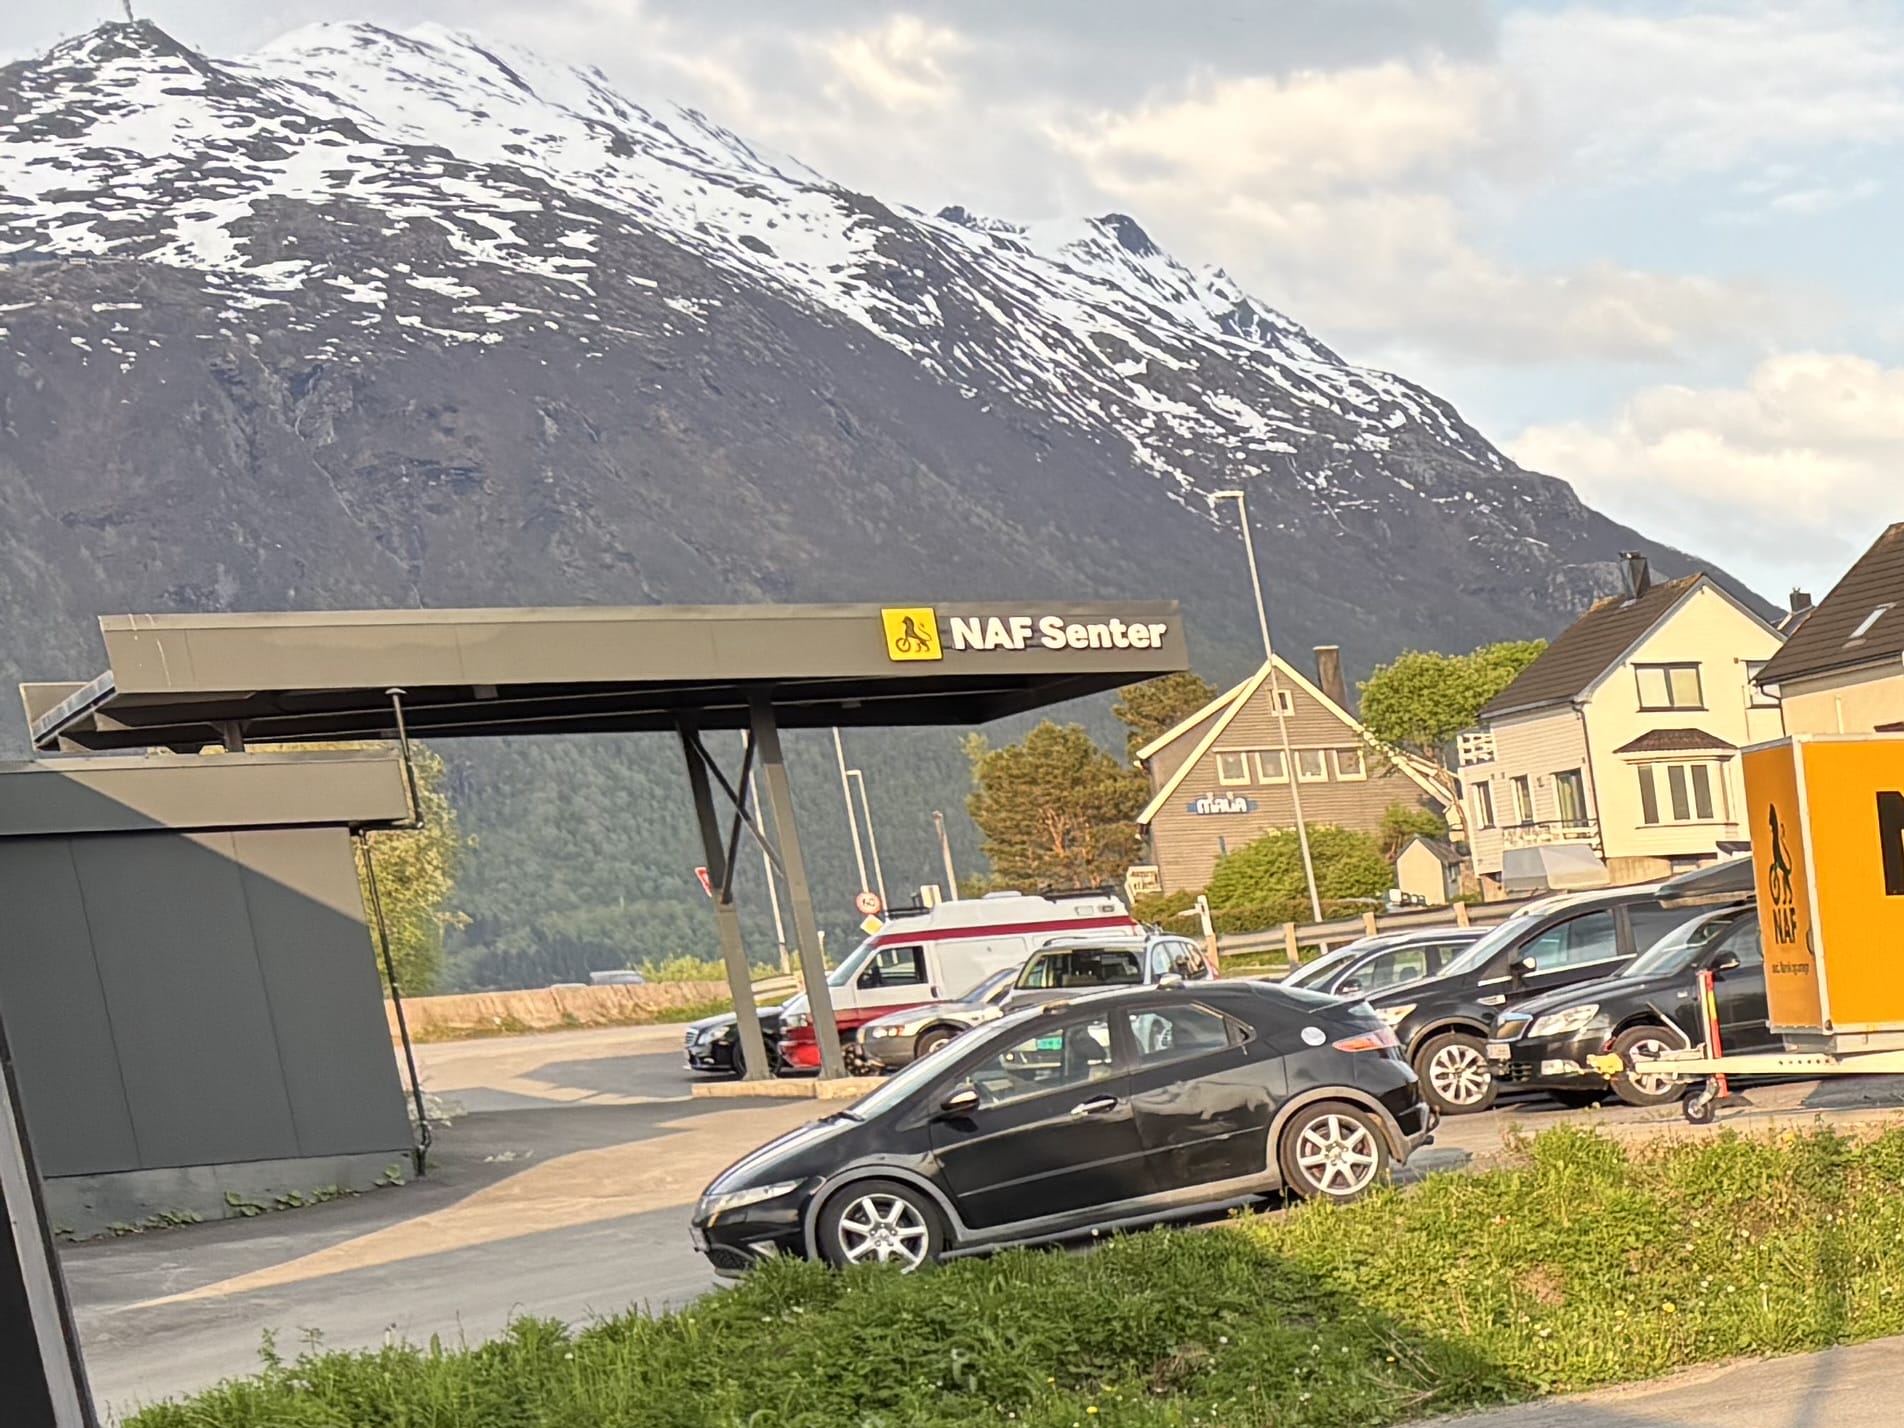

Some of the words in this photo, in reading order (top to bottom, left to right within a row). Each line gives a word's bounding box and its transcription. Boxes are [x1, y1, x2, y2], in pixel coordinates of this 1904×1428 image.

[950, 616, 1032, 650] NAF
[1038, 616, 1167, 649] Senter
[1773, 907, 1797, 944] NAF
